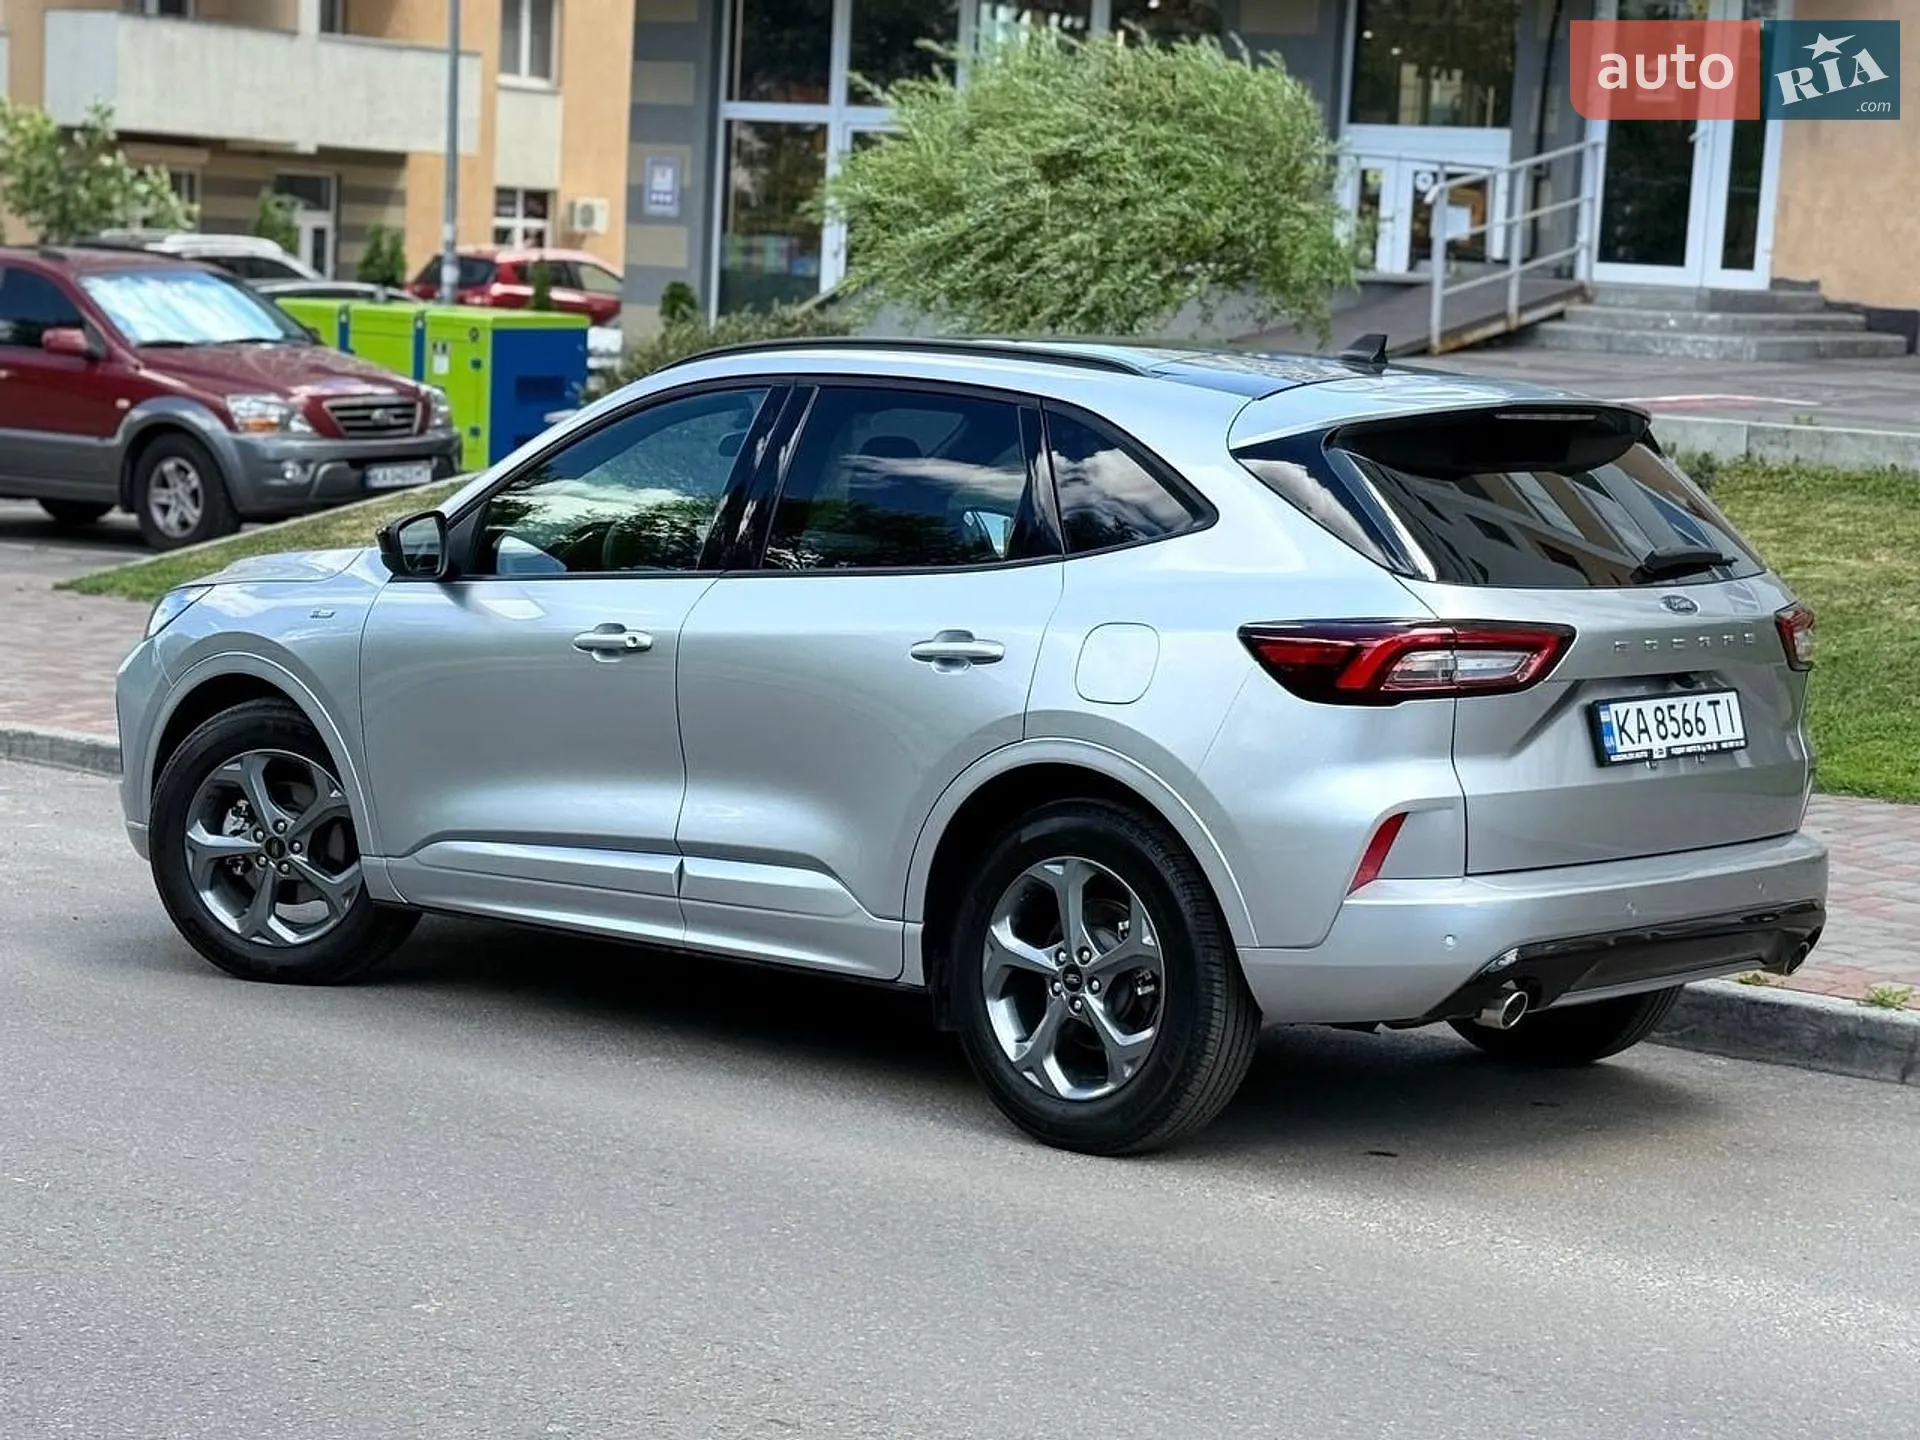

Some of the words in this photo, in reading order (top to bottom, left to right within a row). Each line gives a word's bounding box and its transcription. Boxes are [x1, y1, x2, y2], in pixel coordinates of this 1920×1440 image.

[1615, 708, 1653, 746] KA
[1654, 701, 1707, 741] 8566
[1707, 698, 1736, 735] TI
